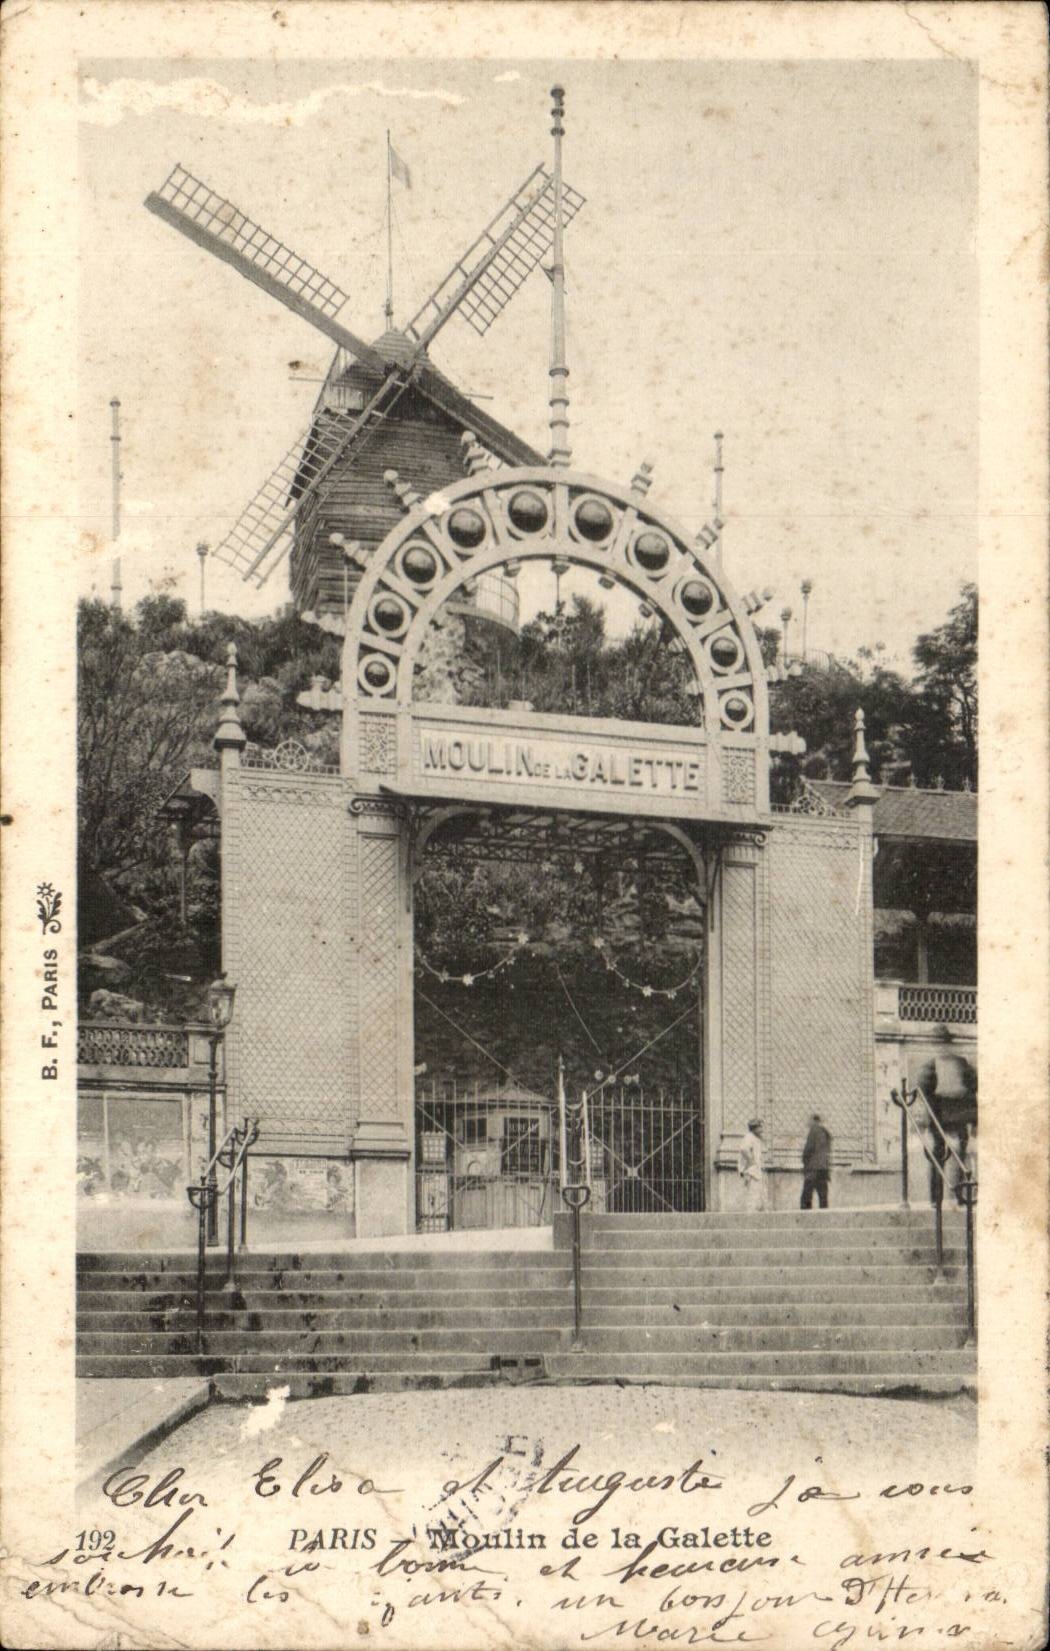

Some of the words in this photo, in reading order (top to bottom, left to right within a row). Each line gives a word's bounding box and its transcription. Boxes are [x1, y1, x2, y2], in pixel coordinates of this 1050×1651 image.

[424, 737, 533, 777] MOULIN
[532, 762, 551, 778] DE
[555, 764, 572, 781] LA
[570, 751, 700, 792] GALETTE
